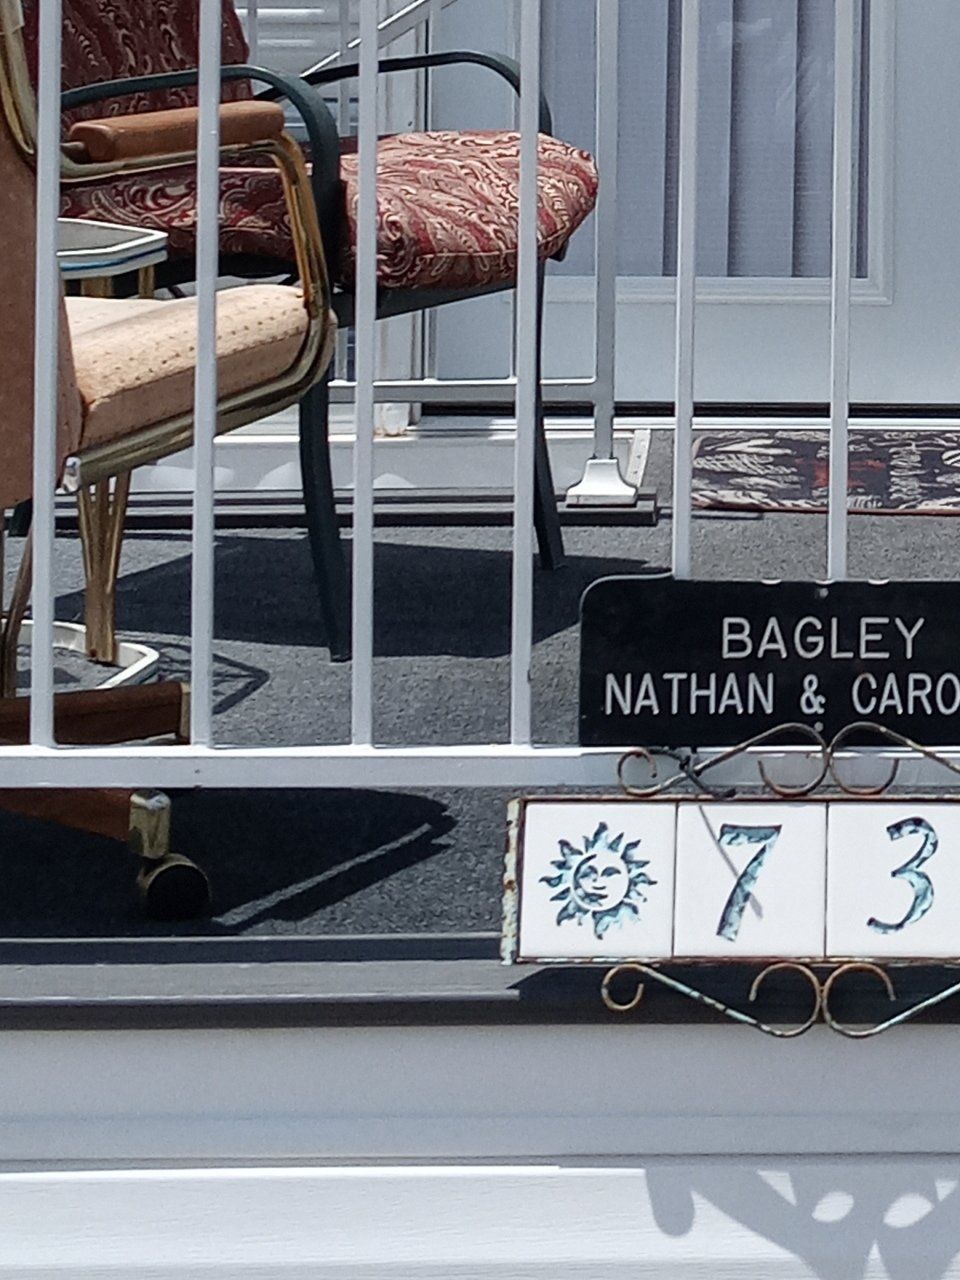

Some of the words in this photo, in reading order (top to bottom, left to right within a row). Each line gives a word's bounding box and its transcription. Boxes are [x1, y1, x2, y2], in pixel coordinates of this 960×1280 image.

[722, 616, 925, 659] BAGLEY
[605, 673, 774, 715] NATHAN
[800, 674, 826, 714] &
